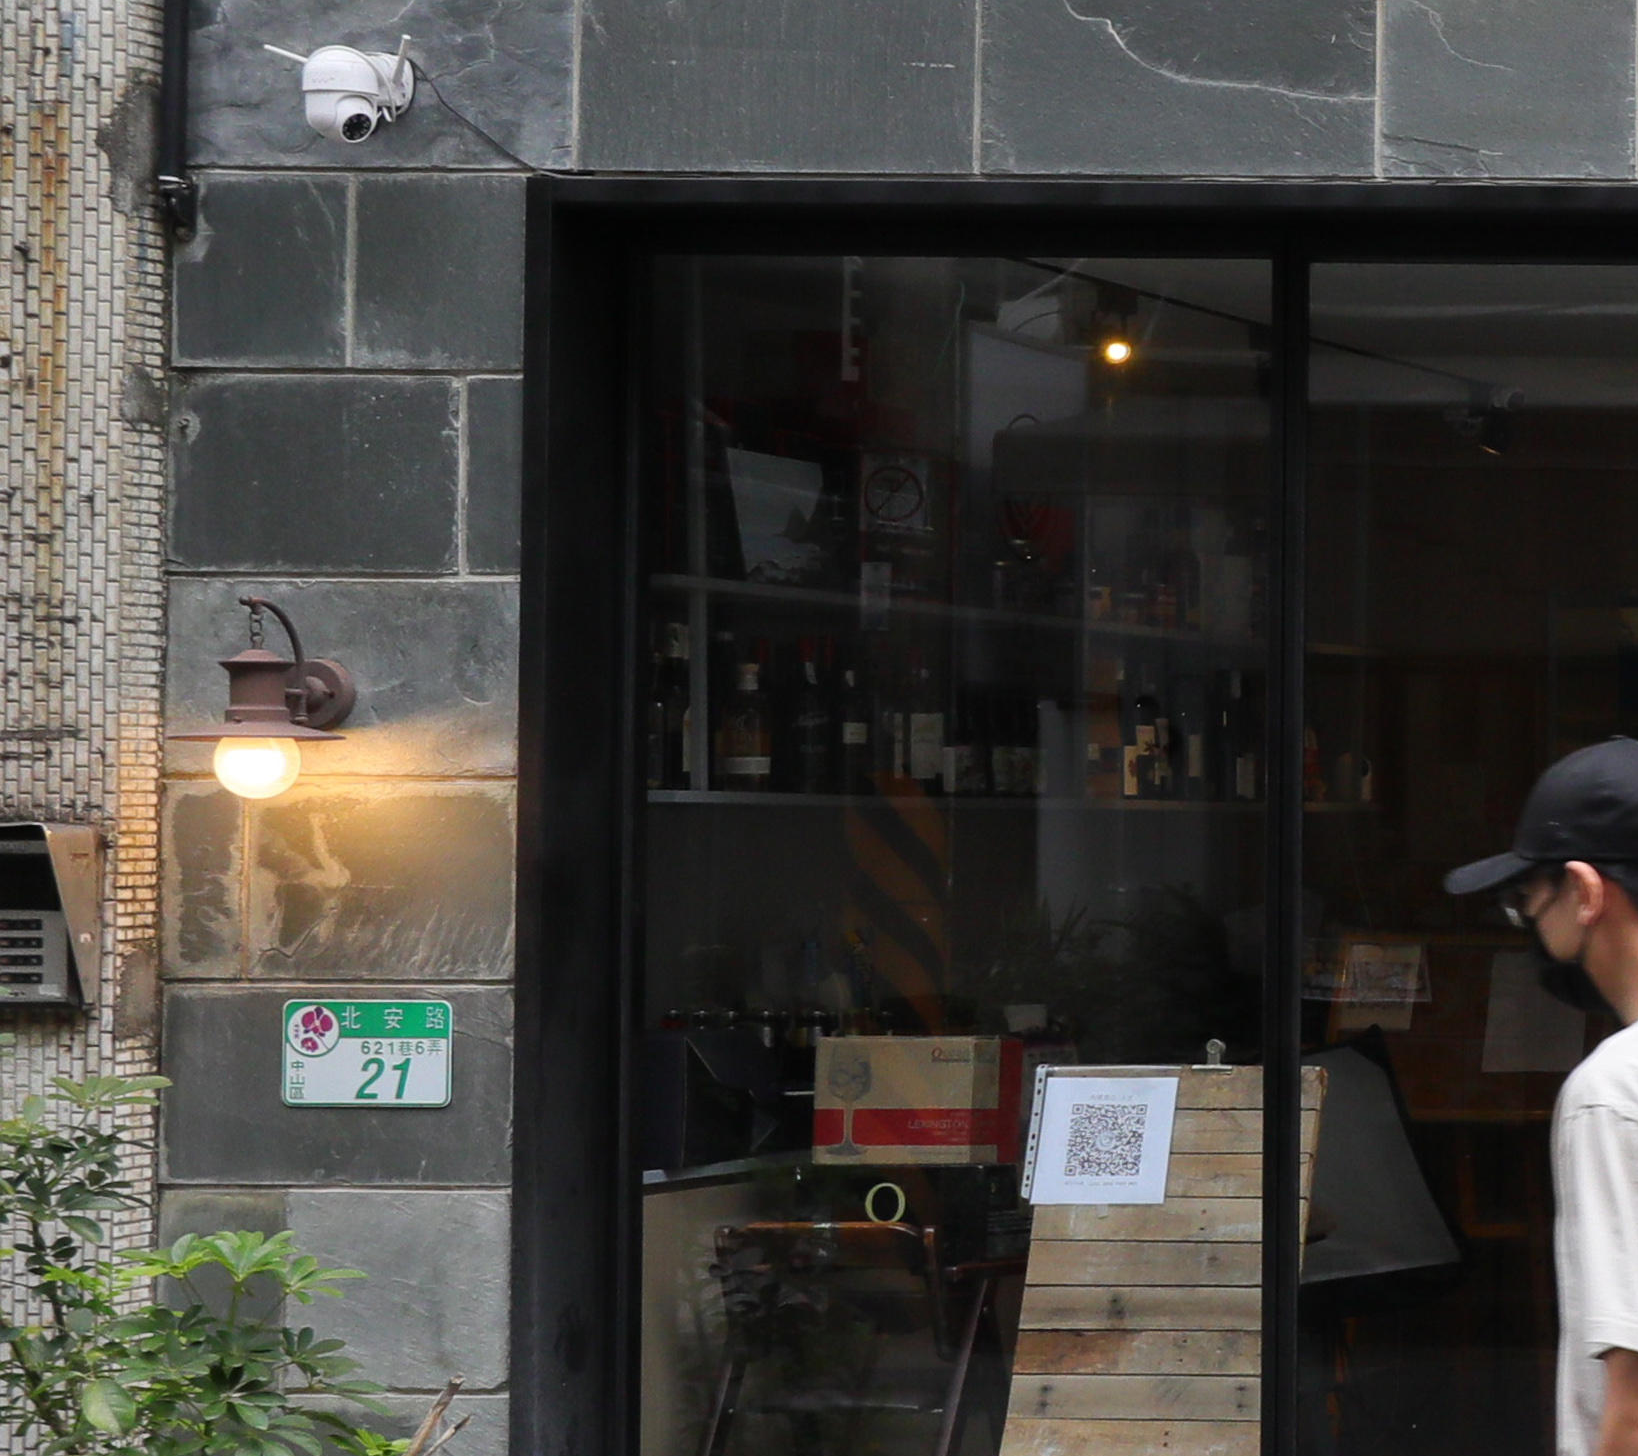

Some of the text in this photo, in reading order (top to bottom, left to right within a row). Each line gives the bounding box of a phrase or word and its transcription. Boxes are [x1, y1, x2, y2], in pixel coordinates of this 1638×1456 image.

[341, 1006, 445, 1030] 北安路
[361, 1039, 443, 1056] 621巷6弄
[290, 1059, 305, 1100] 中山區
[354, 1057, 412, 1100] 21
